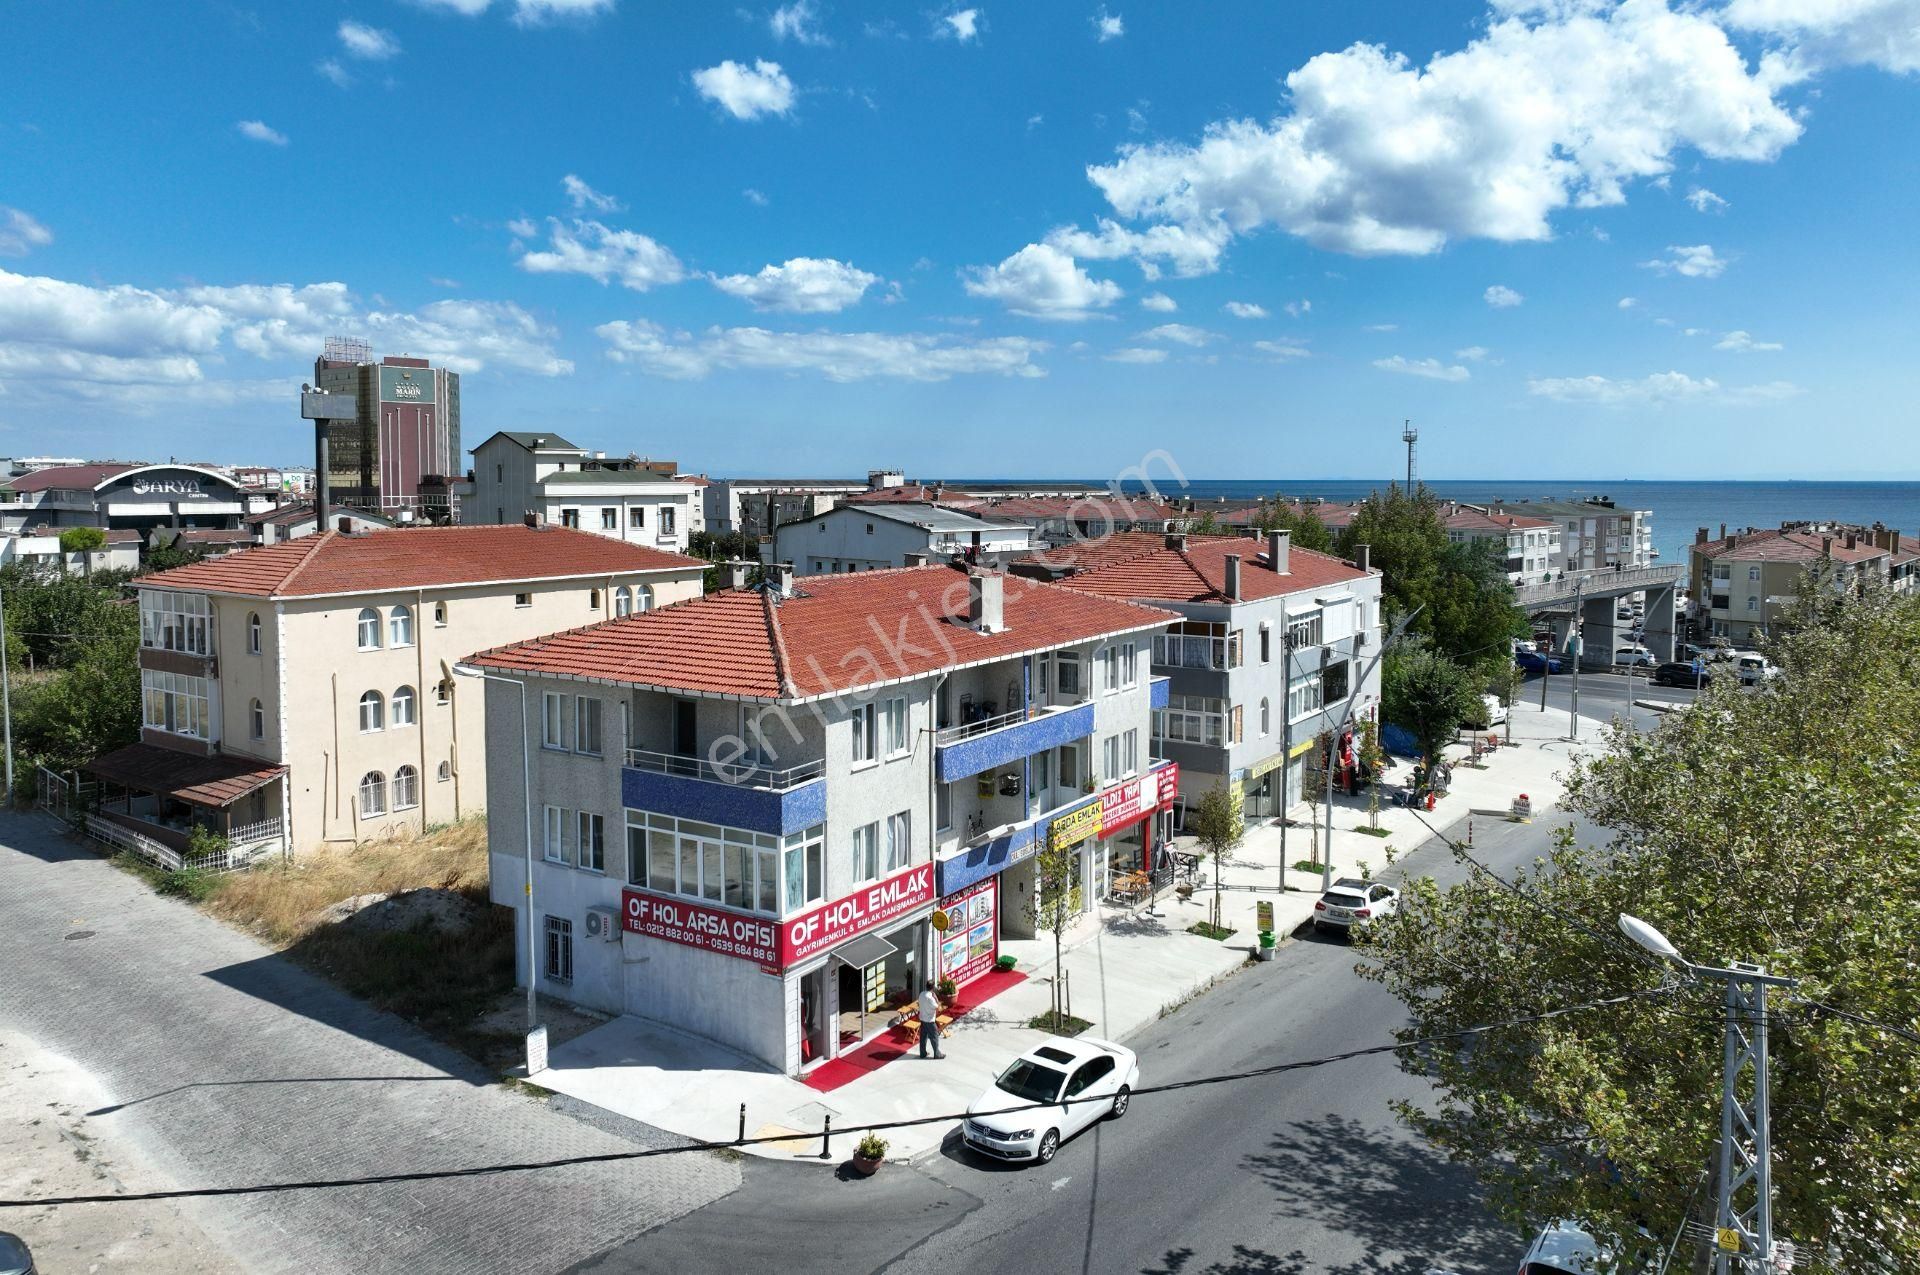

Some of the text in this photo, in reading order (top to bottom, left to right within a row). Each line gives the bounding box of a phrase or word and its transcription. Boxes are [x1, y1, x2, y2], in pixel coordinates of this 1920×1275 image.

[149, 480, 200, 493] ARYA
[1101, 789, 1122, 809] ILDIZ
[1124, 781, 1140, 801] YAPI
[1077, 804, 1100, 822] EMLAK
[791, 868, 929, 946] OF HOL EMLAK
[941, 896, 950, 908] OF
[950, 892, 963, 904] HOL
[629, 898, 775, 948] OF HOL ARSA OFİSİ
[857, 912, 881, 929] EMLAK
[629, 918, 645, 931] TEL:
[646, 923, 664, 936] 0212
[665, 927, 682, 939] 882
[683, 931, 694, 942] 00
[695, 934, 704, 945] 61
[711, 938, 733, 952] 0539
[734, 943, 752, 956] 684
[753, 948, 765, 959] 88
[766, 951, 776, 962] 61
